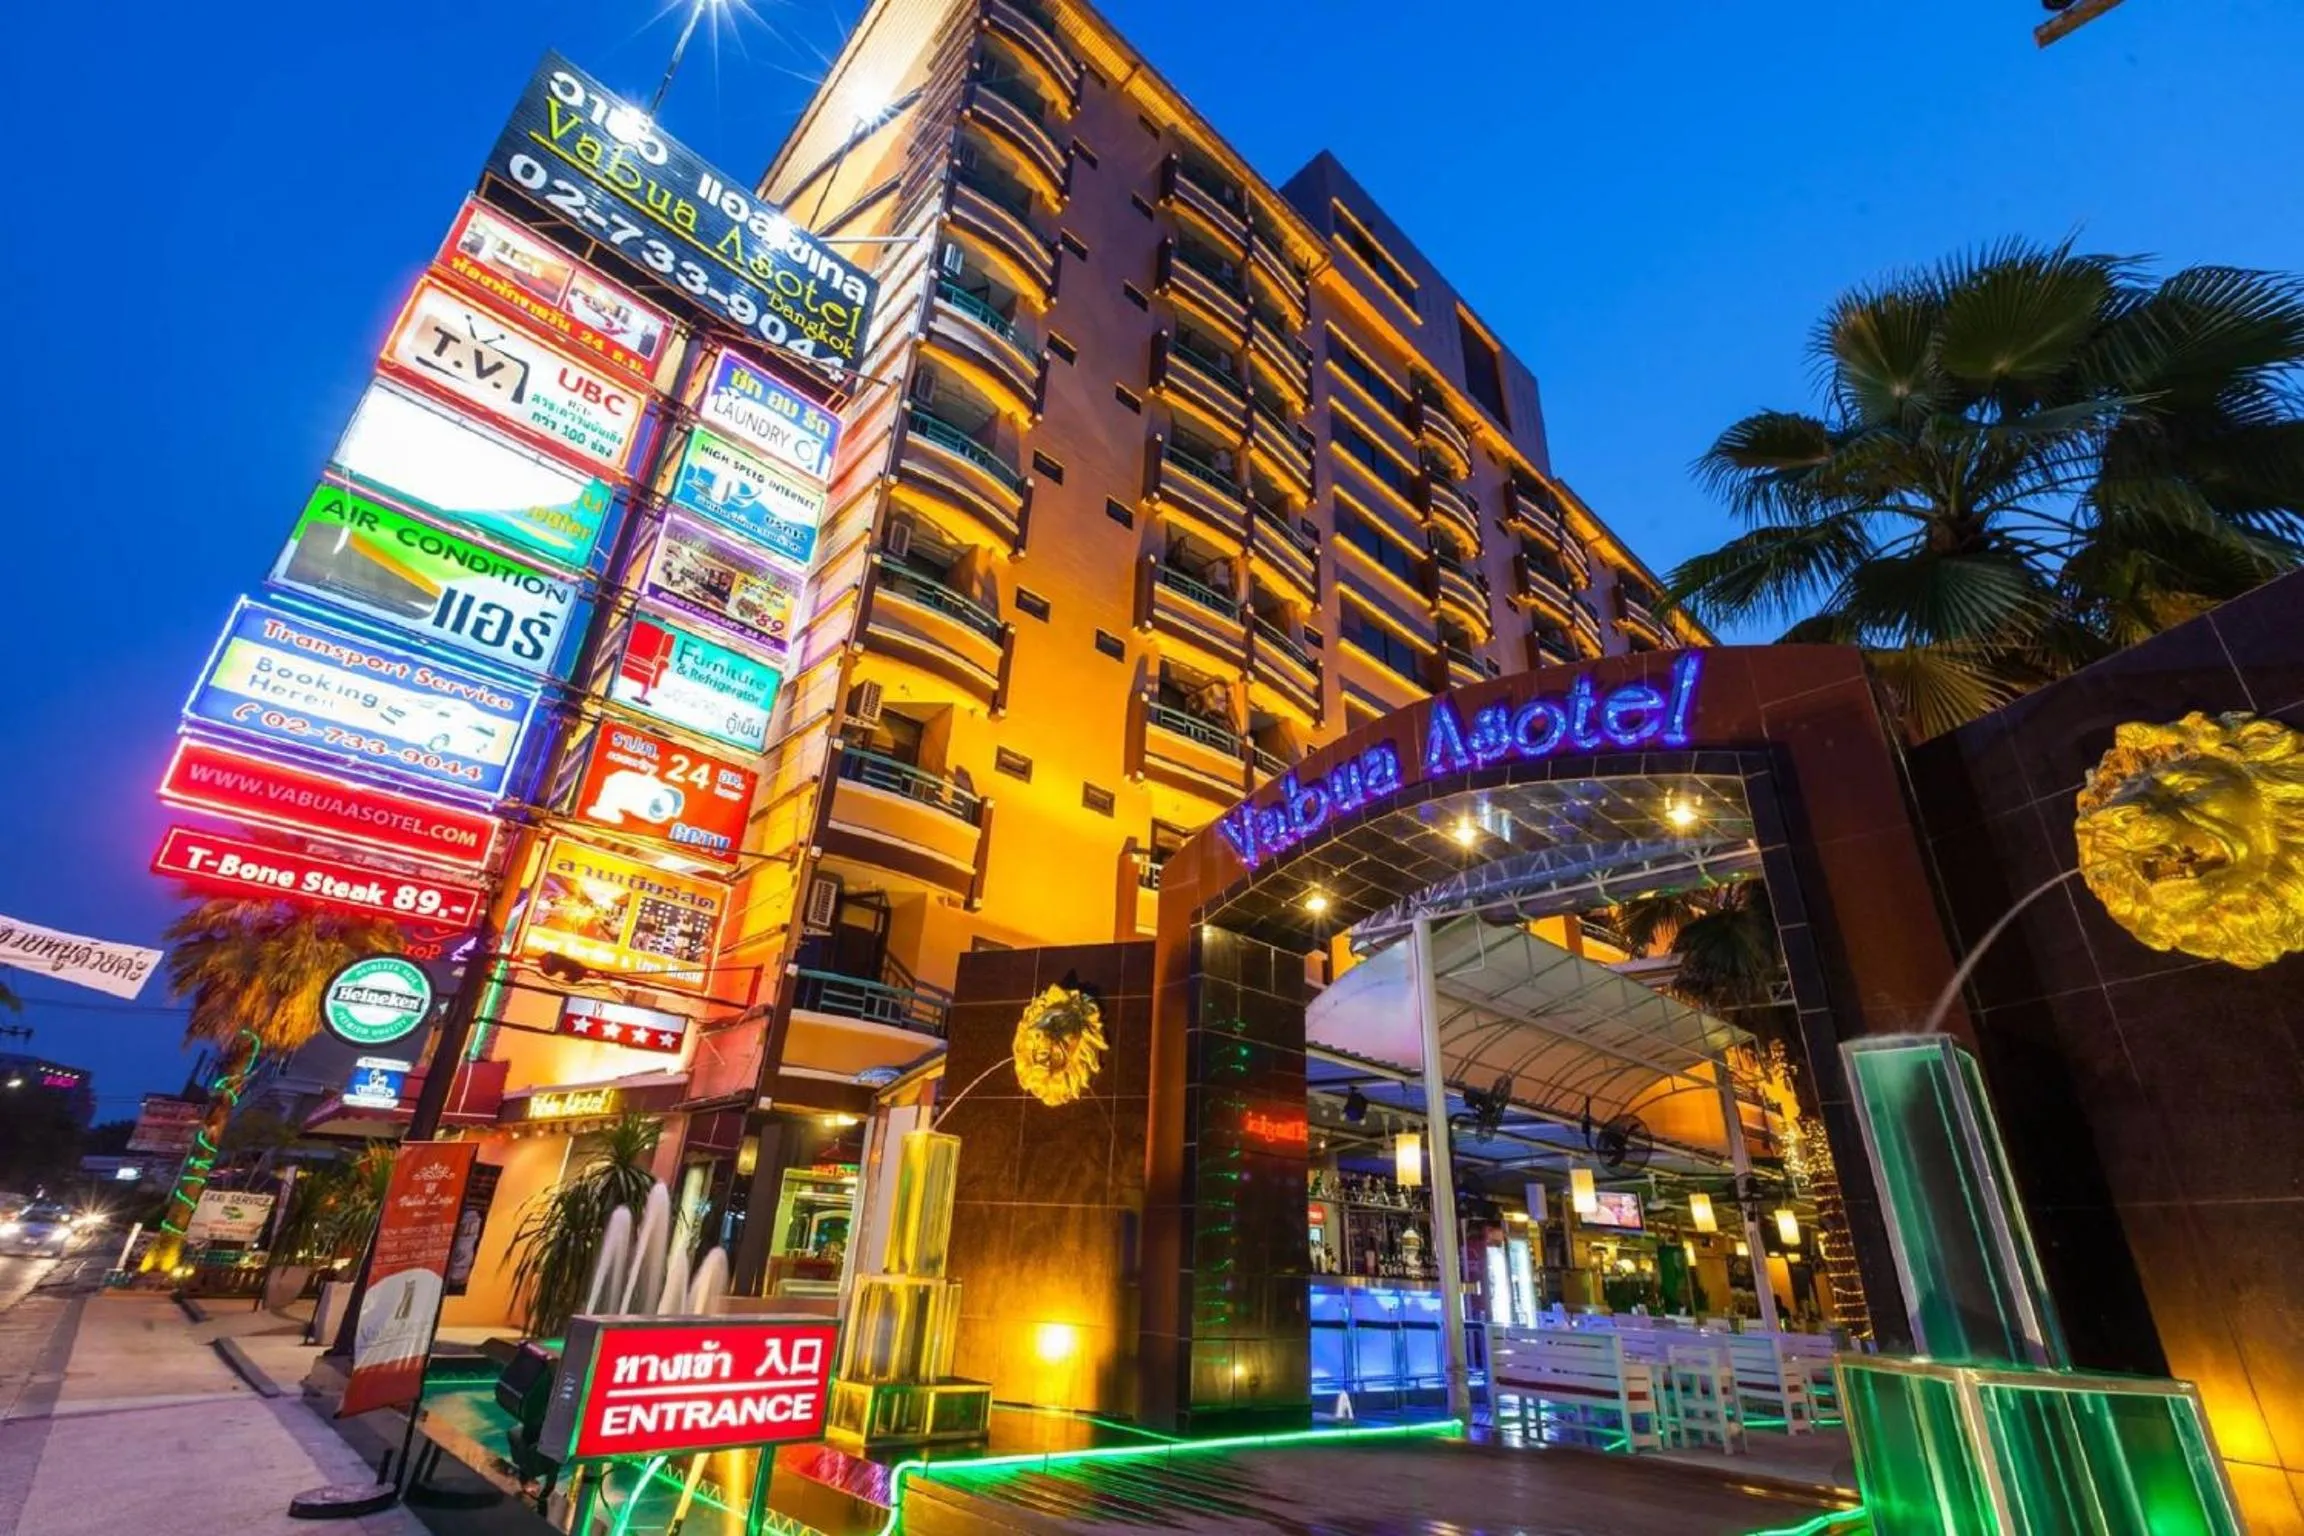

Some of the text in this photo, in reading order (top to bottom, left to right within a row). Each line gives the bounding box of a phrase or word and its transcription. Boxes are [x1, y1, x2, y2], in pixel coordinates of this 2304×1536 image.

[546, 95, 862, 338] Vabua Asotel
[509, 154, 845, 382] 02-733-9044
[580, 330, 604, 351] 24
[768, 293, 855, 360] Bangkok
[433, 326, 506, 390] T.V.
[558, 368, 627, 417] UBC
[562, 420, 588, 445] 100
[714, 398, 791, 449] LAUNDRY
[701, 444, 816, 511] HIGH SPEED INTERNET
[322, 499, 567, 605] AIR CONDITION
[432, 586, 558, 661] แอร์
[255, 656, 378, 709] Booking
[264, 619, 514, 711] Transport Service
[677, 640, 767, 691] Furniture
[689, 667, 760, 701] Refrigerator
[262, 711, 483, 782] 02-733-9044
[665, 754, 711, 790] 24
[1217, 651, 1701, 872] Vabua Asotel
[189, 764, 478, 847] WWW.VABUAASOTEL.COM
[187, 845, 296, 888] T-Bone
[303, 870, 386, 906] Steak
[393, 887, 466, 918] 89.-
[338, 986, 421, 1010] Heineken
[612, 1340, 733, 1383] ทางเข้า
[755, 1338, 823, 1377] 入口
[601, 1393, 816, 1437] ENTRANCE
